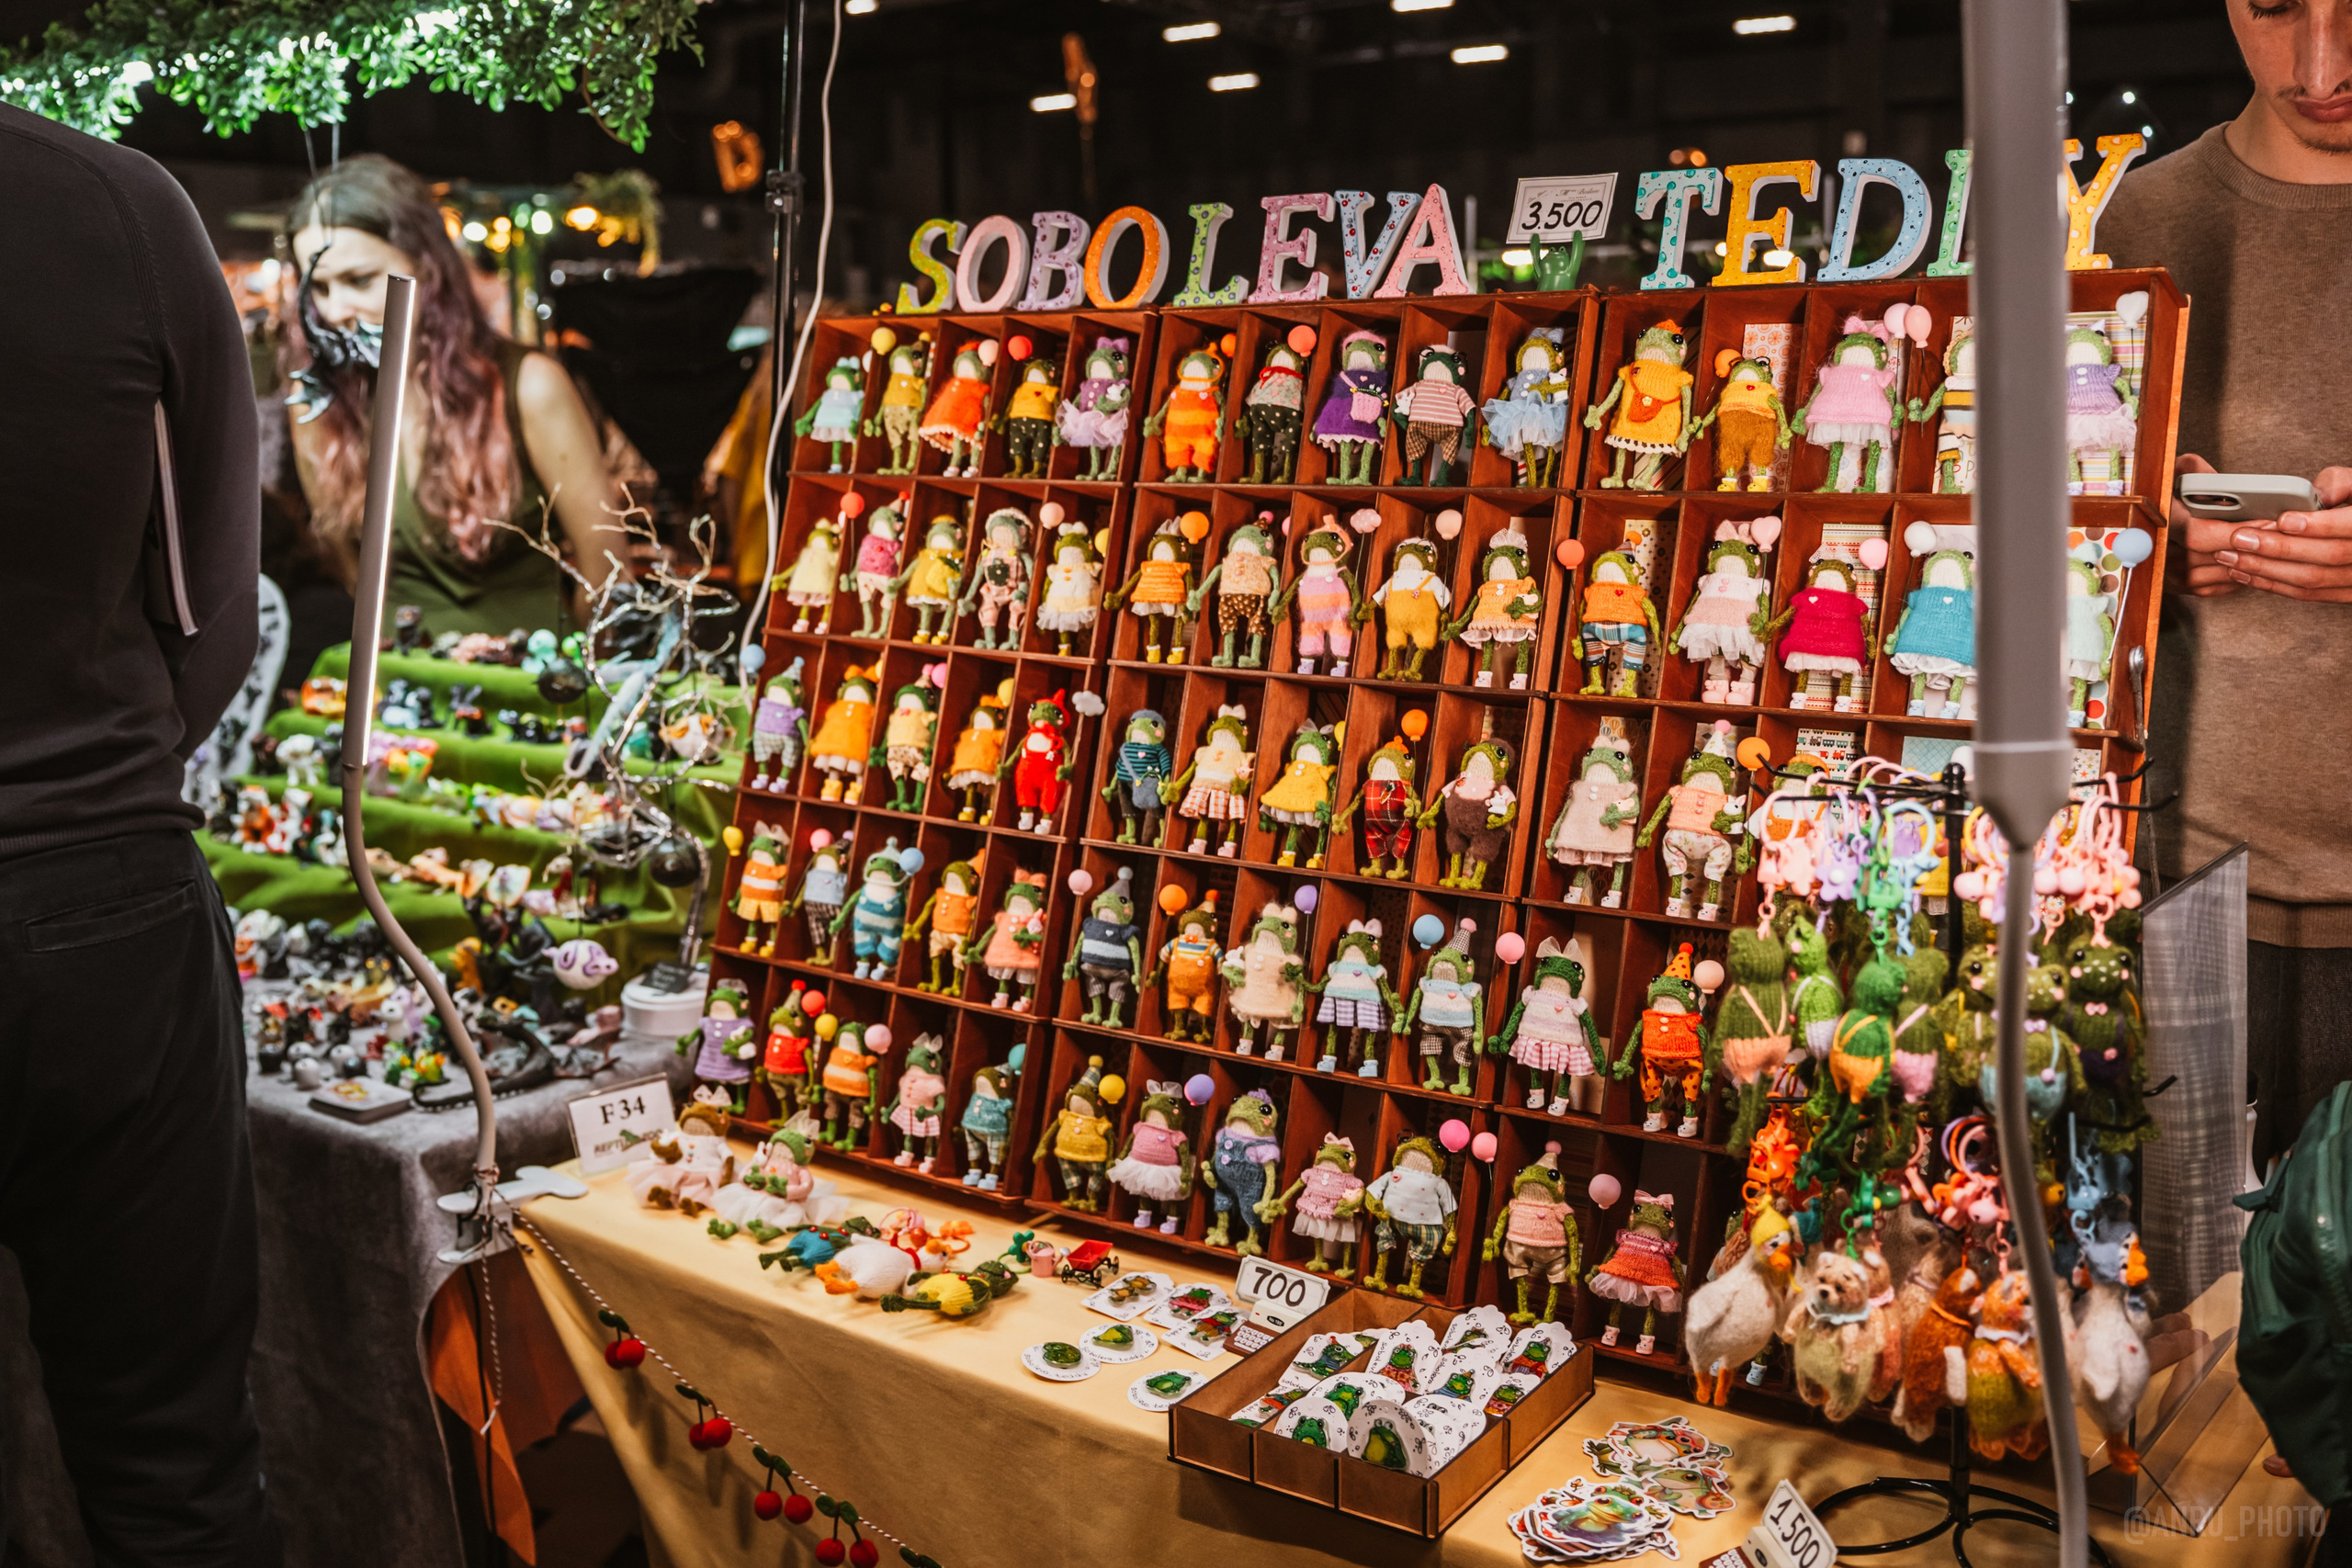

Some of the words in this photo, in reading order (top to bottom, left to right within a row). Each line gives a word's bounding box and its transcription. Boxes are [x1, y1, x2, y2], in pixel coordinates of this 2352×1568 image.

[1521, 199, 1604, 231] 3.500
[896, 184, 1476, 314] SOBOLEVA
[599, 1096, 647, 1125] F34
[1252, 1266, 1306, 1307] 700
[1769, 1498, 1820, 1568] 1.500
